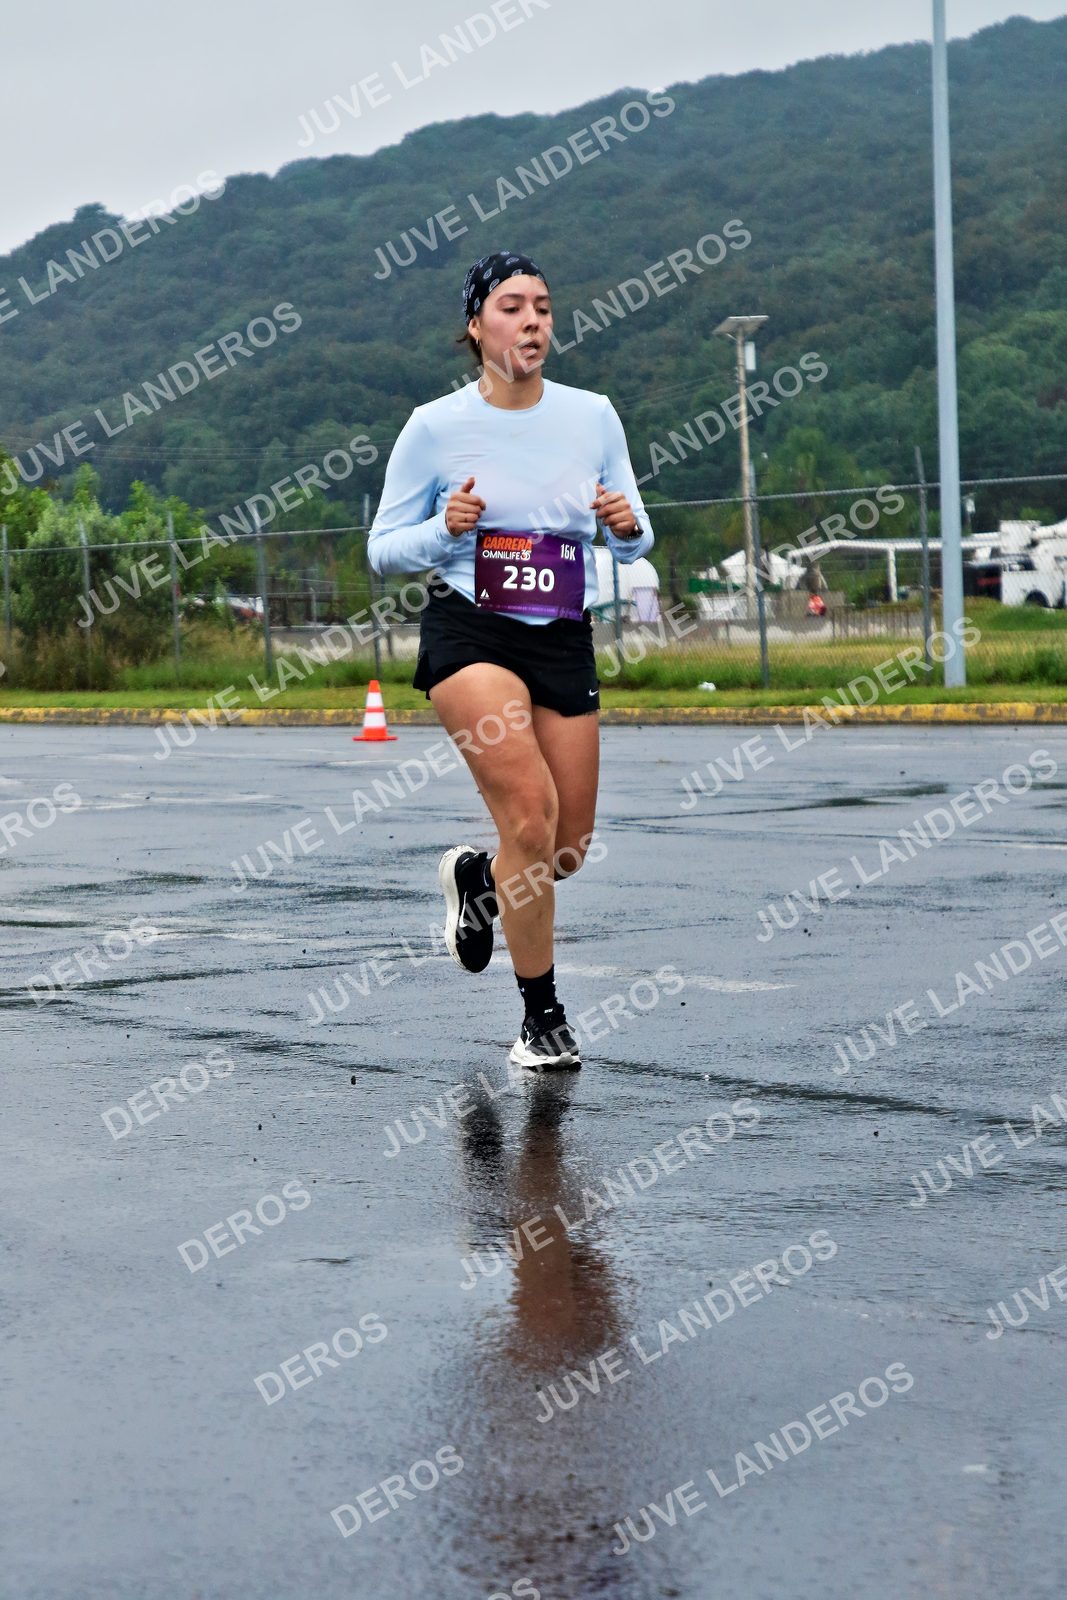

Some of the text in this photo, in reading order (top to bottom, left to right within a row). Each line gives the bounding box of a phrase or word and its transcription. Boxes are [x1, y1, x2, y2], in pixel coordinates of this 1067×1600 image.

[483, 536, 533, 551] CARRERA
[482, 549, 521, 560] OMNILIFE
[560, 543, 576, 561] 16K
[502, 565, 555, 592] 230
